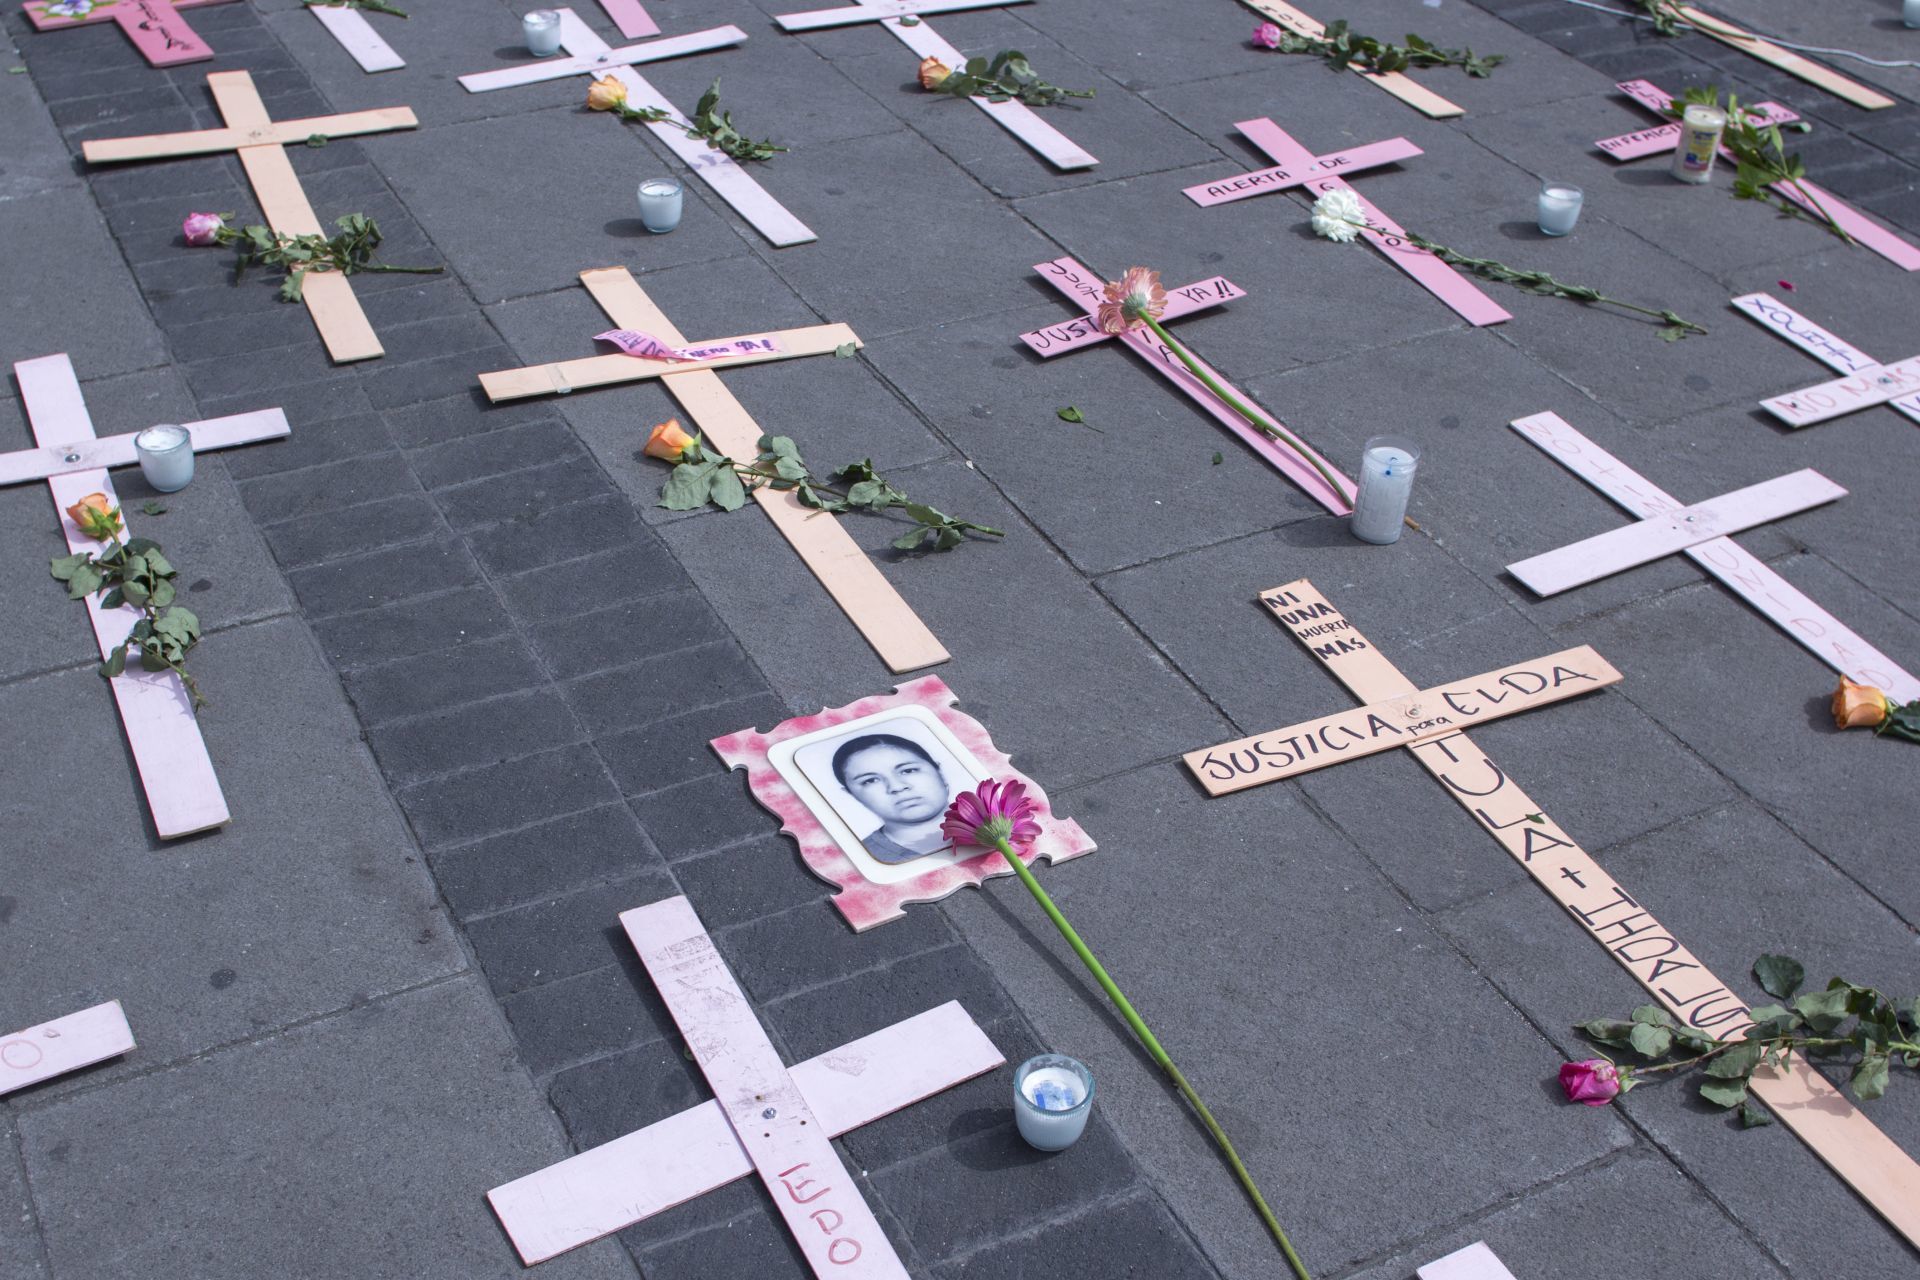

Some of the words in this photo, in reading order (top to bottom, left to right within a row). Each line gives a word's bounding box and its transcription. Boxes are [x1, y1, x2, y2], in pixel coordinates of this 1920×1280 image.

[1207, 169, 1291, 197] ALERTA
[1318, 155, 1352, 169] DE
[1774, 392, 1837, 418] NO
[1523, 422, 1582, 454] NO
[1623, 483, 1894, 691] IMUNIDAD
[1264, 591, 1301, 609] NI
[1281, 602, 1337, 625] UNA
[1298, 619, 1352, 640] MUERTA
[1201, 713, 1403, 780] JUSTICIA
[1406, 715, 1453, 736] para
[1441, 665, 1598, 716] ELDA
[1412, 732, 1575, 861] TULA
[778, 1162, 862, 1265] EDO
